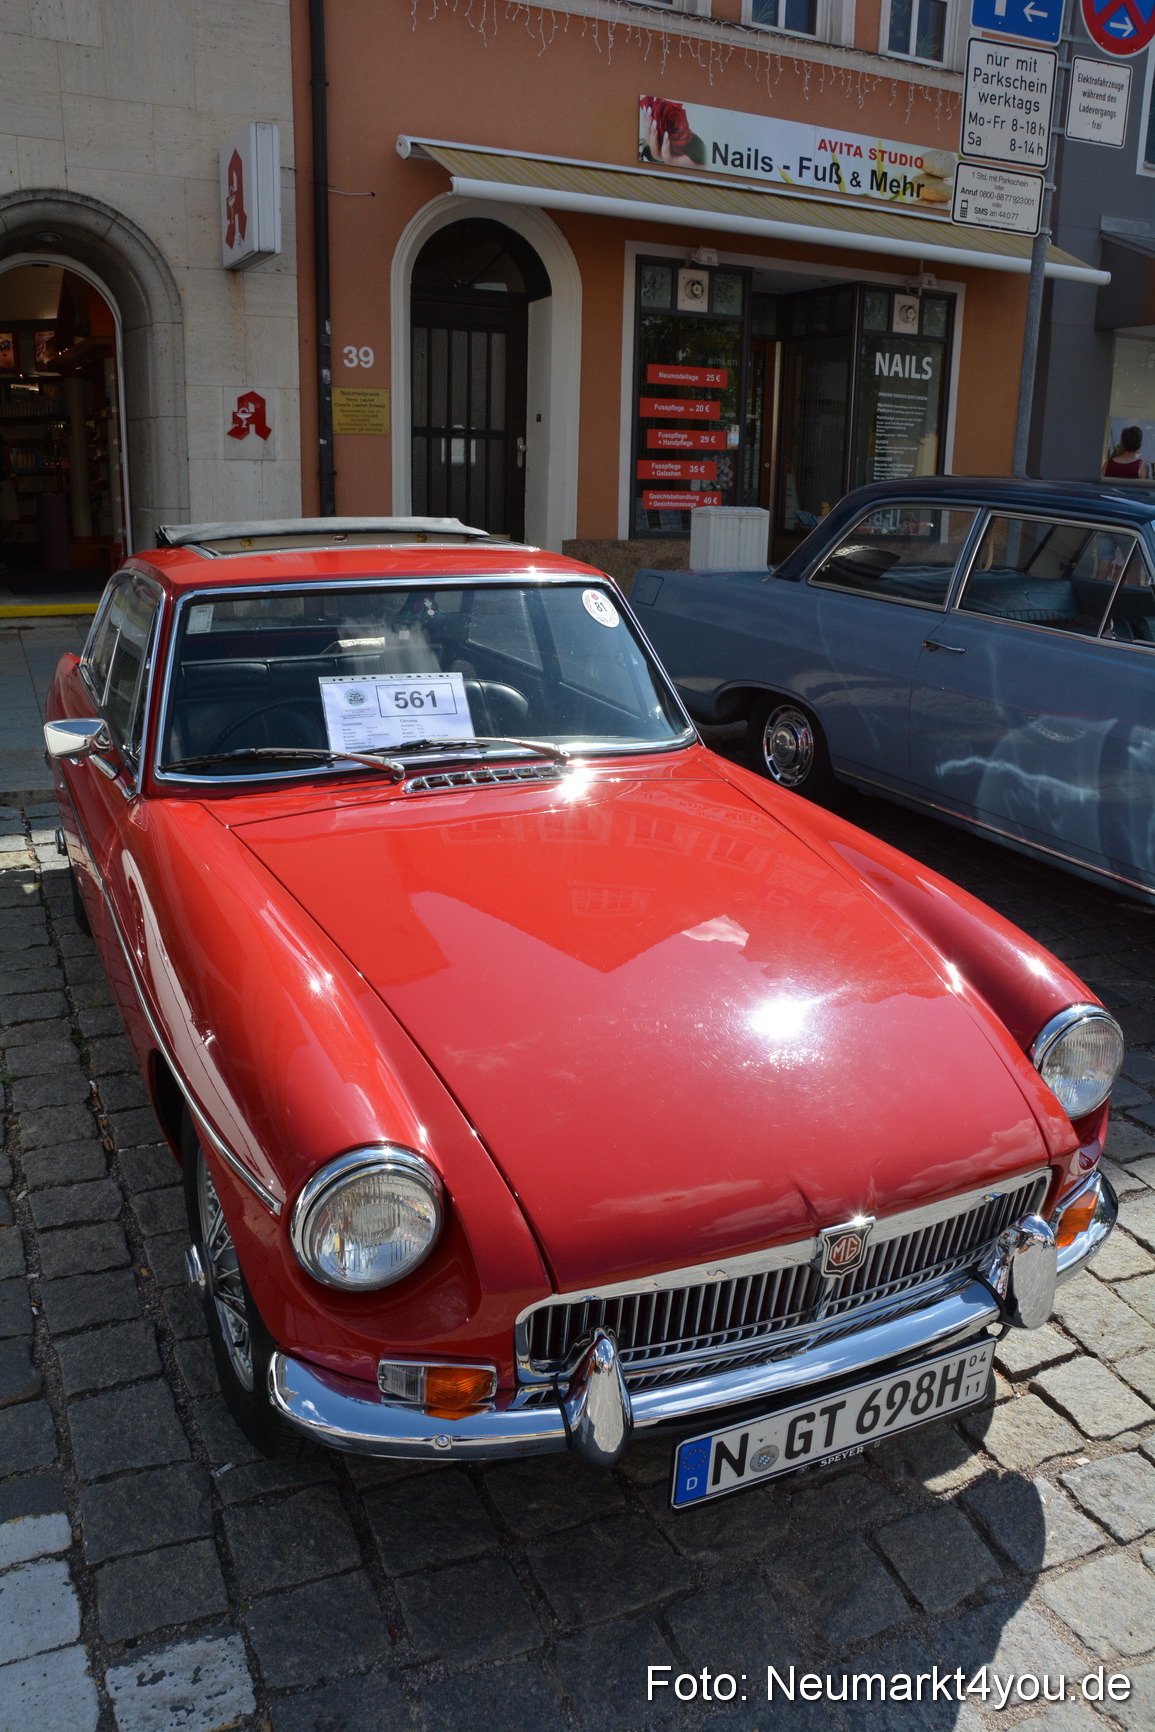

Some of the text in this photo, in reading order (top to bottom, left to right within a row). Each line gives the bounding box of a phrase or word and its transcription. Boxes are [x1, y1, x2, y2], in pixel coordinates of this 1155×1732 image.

[986, 53, 1037, 73] nur mit
[973, 67, 1047, 94] Parkschein
[1078, 73, 1124, 92] Elektrofahrzeuge
[978, 92, 1040, 114] werktags
[1082, 89, 1116, 103] während des
[1078, 103, 1116, 120] Ladevorgangs
[1092, 120, 1102, 130] frei
[968, 132, 982, 146] Sa
[817, 138, 924, 169] AVITA STUDIO
[711, 142, 774, 174] Nails
[798, 156, 842, 185] Fuß
[850, 171, 862, 188] &
[870, 168, 925, 198] Mehr
[999, 176, 1028, 187] Parkschein
[960, 187, 978, 196] Anruf
[974, 206, 988, 216] SMS
[343, 346, 374, 368] 39
[875, 352, 932, 380] NAILS
[658, 372, 698, 381] Neumodellage
[706, 374, 714, 382] 25
[654, 404, 684, 412] Fusspflege
[649, 493, 699, 501] Gesichtsbehandlung
[394, 690, 438, 710] 561
[833, 1238, 858, 1262] MG
[969, 1351, 986, 1367] 04
[965, 1381, 980, 1397] 11
[686, 1358, 966, 1491] D N GT 698H
[820, 1446, 864, 1467] SPEYER
